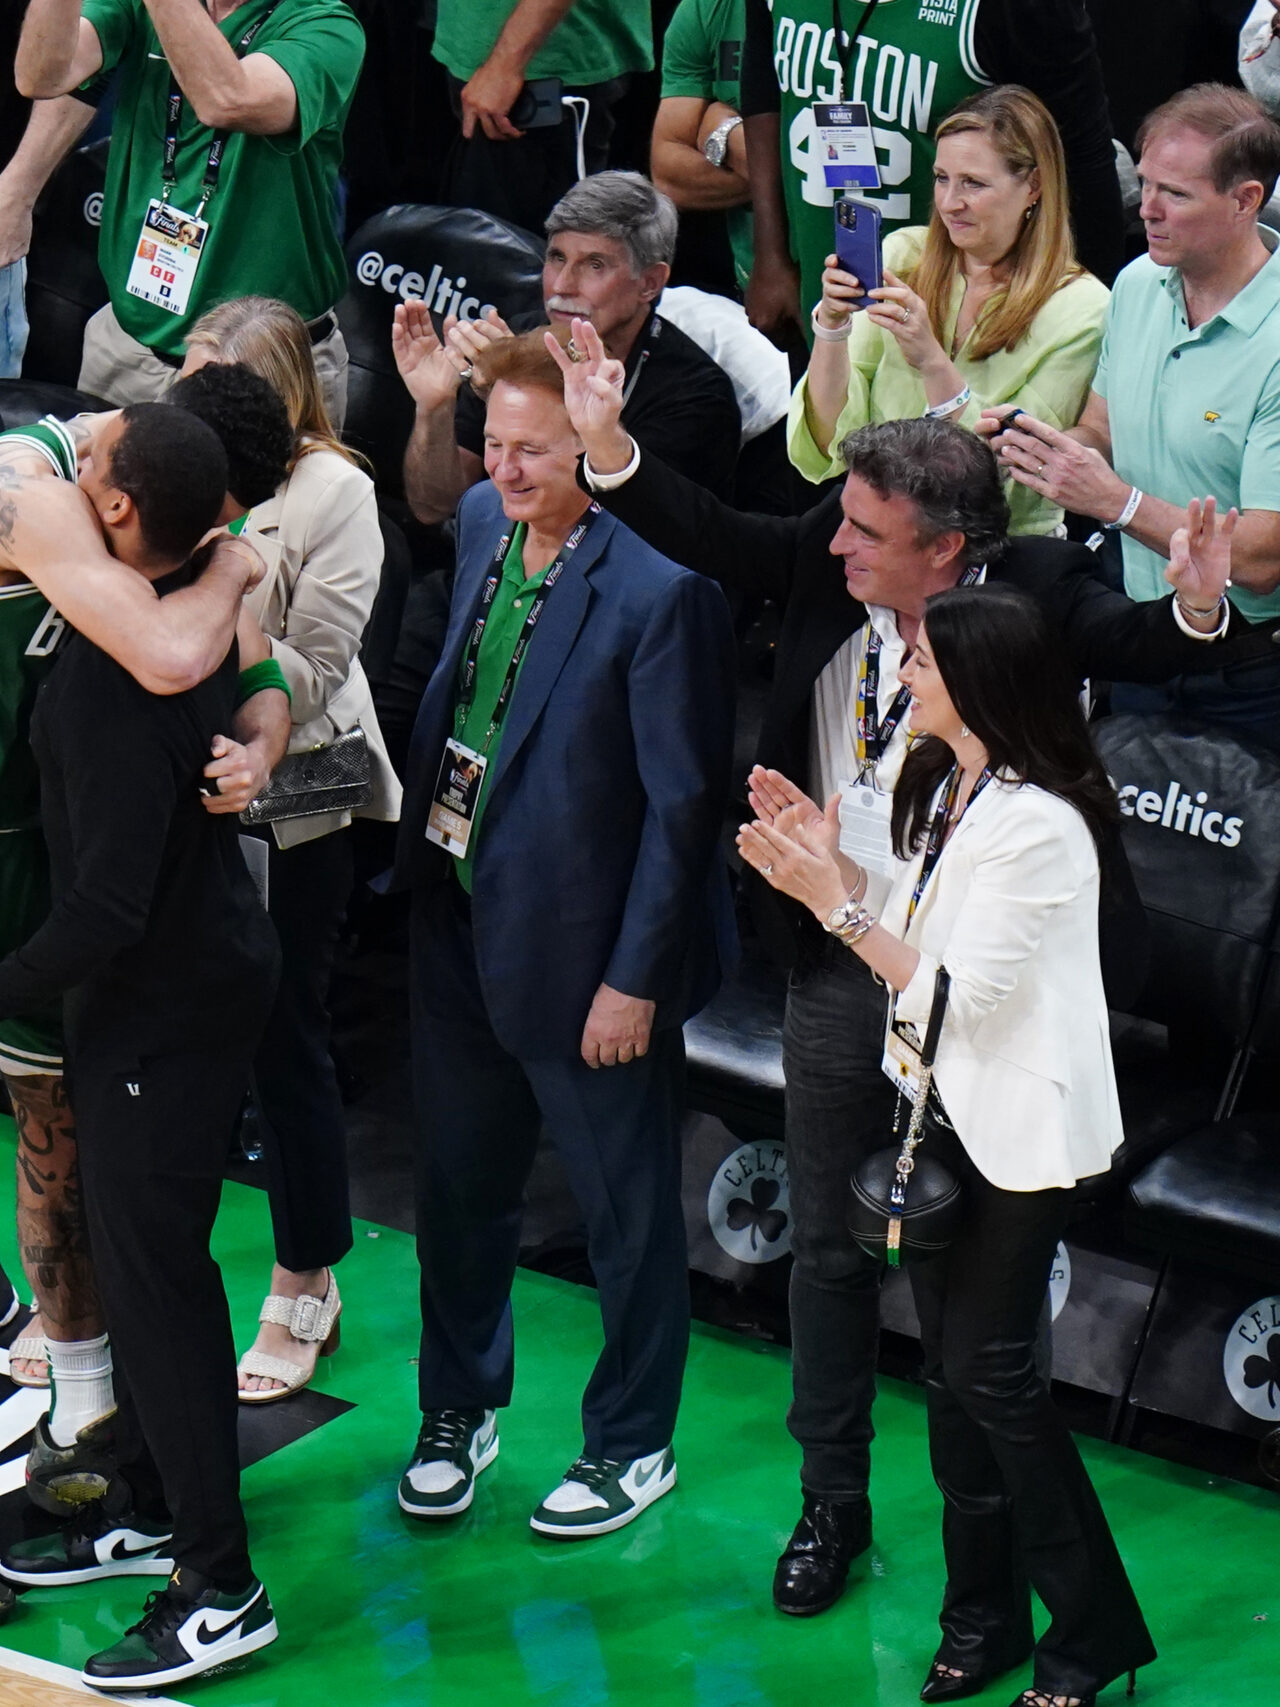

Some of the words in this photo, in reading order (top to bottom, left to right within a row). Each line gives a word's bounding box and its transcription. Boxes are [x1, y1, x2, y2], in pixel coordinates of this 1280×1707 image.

[918, 8, 956, 26] PRINT
[774, 16, 938, 133] BOSTON
[1107, 775, 1244, 847] celtics
